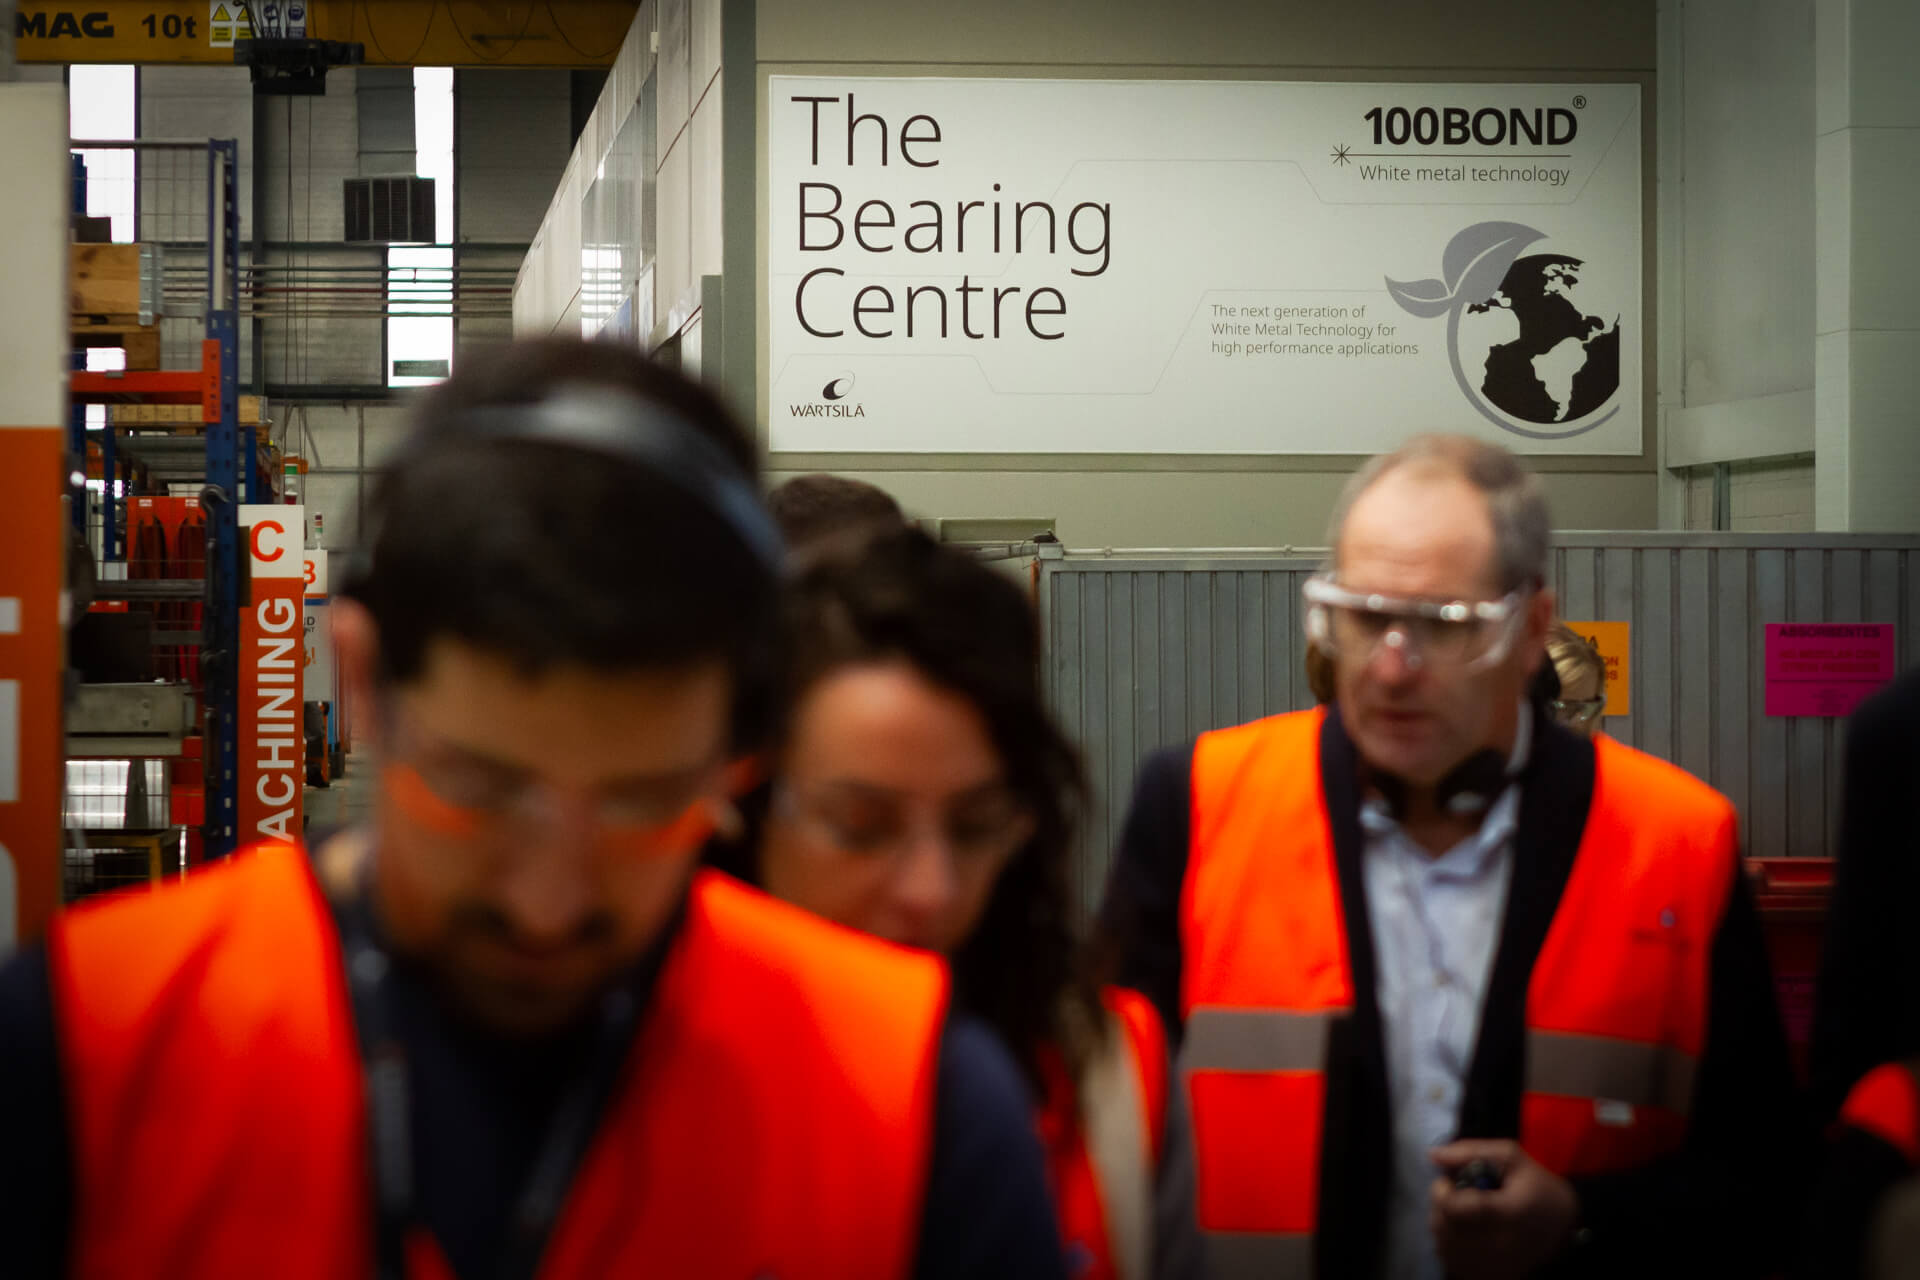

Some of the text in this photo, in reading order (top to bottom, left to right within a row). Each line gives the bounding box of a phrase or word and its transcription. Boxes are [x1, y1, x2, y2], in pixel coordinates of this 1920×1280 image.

[142, 14, 197, 38] 10t
[791, 93, 942, 168] The
[1359, 164, 1571, 187] White metal technology
[799, 182, 1112, 277] Bearing
[795, 267, 1067, 341] Centre
[1212, 304, 1367, 321] The next generation of
[1211, 323, 1397, 340] White Metal Technology for
[1211, 341, 1420, 358] high performance applications
[250, 520, 285, 563] C
[256, 598, 296, 845] ACHINING
